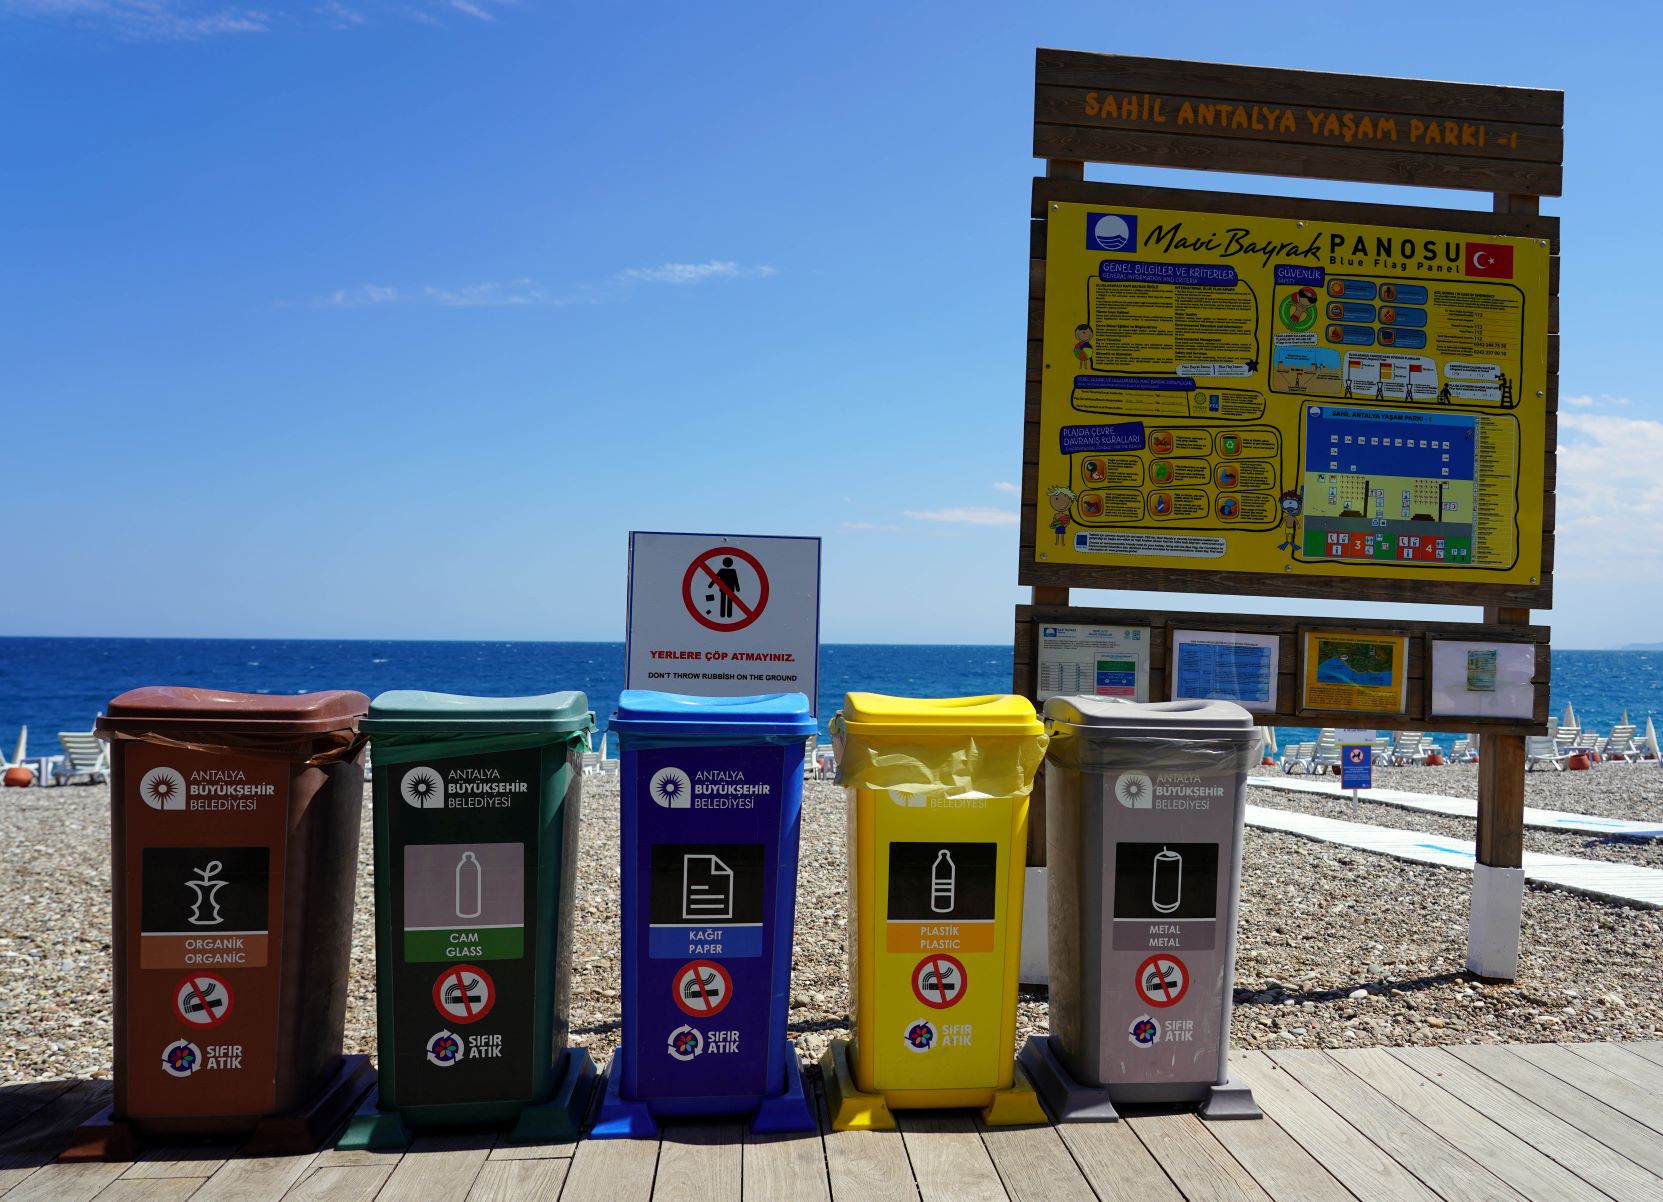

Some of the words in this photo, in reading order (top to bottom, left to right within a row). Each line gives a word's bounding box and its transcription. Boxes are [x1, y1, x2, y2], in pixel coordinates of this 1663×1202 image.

[1177, 99, 1297, 134] ANTALYA
[1306, 110, 1398, 143] YAŞAM
[1409, 118, 1487, 148] PARKI
[1143, 222, 1221, 254] Mavi
[1219, 228, 1323, 268] Bayrak
[1329, 233, 1461, 263] PANOSU
[1103, 262, 1133, 273] GENEL
[1134, 263, 1174, 276] BİLGİLER
[1175, 267, 1188, 277] VE
[1329, 256, 1364, 267] Blue
[1374, 259, 1407, 271] Flag
[1417, 262, 1460, 274] Panel
[1352, 411, 1381, 419] ANTALYA
[1354, 541, 1361, 549] 3
[1425, 544, 1433, 552] 4
[650, 650, 702, 660] YERLERE
[705, 650, 728, 661] ÇÖP
[731, 652, 796, 663] ATMAYINIZ.
[737, 673, 748, 681] ON
[765, 674, 798, 682] GROUND
[190, 770, 246, 781] ANTALYA
[448, 769, 501, 779] ANTALYA
[695, 770, 745, 781] ANTALYA
[1156, 771, 1201, 783] ANTALYA
[190, 782, 275, 797] BÜYÜKŞEHİR
[448, 780, 528, 795] BÜYÜKŞEHİR
[694, 781, 770, 797] BÜYÜKŞEHİR
[1155, 785, 1224, 798] BÜYÜKŞEHİR
[190, 797, 257, 810] BELEDİYESİ
[448, 795, 512, 808] BELEDİYESİ
[694, 796, 754, 809] BELEDİYESİ
[1155, 798, 1210, 810] BELEDİYESİ
[689, 928, 723, 940] KAĞIT
[920, 924, 959, 935] PLASTİK
[1149, 925, 1181, 934] METAL
[184, 936, 244, 949] ORGANİK
[449, 932, 479, 943] CAM
[1149, 938, 1180, 947] METAL
[689, 944, 723, 954] PAPER
[919, 939, 961, 949] PLASTIC
[446, 946, 483, 957] GLASS
[941, 1024, 973, 1035] SIFIR
[1165, 1020, 1194, 1031] SIFIR
[468, 1034, 503, 1047] SIFIR
[707, 1030, 740, 1042] SIFIR
[942, 1034, 972, 1047] ATIK
[1165, 1030, 1193, 1042] ATIK
[206, 1045, 243, 1057] SIFIR
[469, 1045, 502, 1059] ATIK
[707, 1041, 739, 1053] ATIK
[206, 1057, 242, 1069] ATIK
